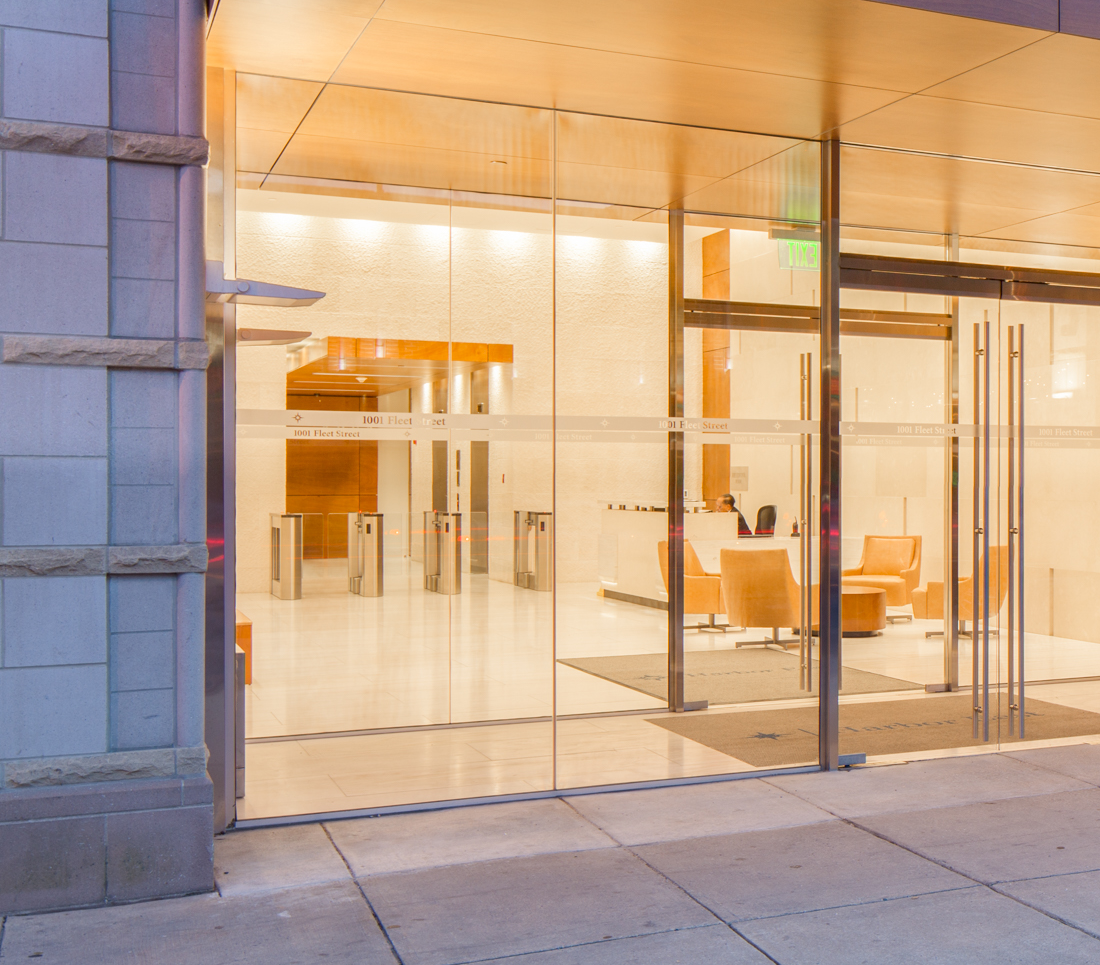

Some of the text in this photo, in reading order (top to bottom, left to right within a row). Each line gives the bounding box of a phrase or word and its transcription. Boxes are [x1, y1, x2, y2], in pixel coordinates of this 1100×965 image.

[362, 415, 384, 425] 1001
[387, 415, 413, 426] Fleet
[658, 420, 729, 430] 1001 Fleet Street
[293, 429, 361, 438] 1001 Fleet Street
[896, 425, 957, 435] 1001 Fleet Strt
[1038, 428, 1093, 437] 1001 Fleet Street
[555, 433, 570, 441] leet
[749, 436, 766, 444] Fleet
